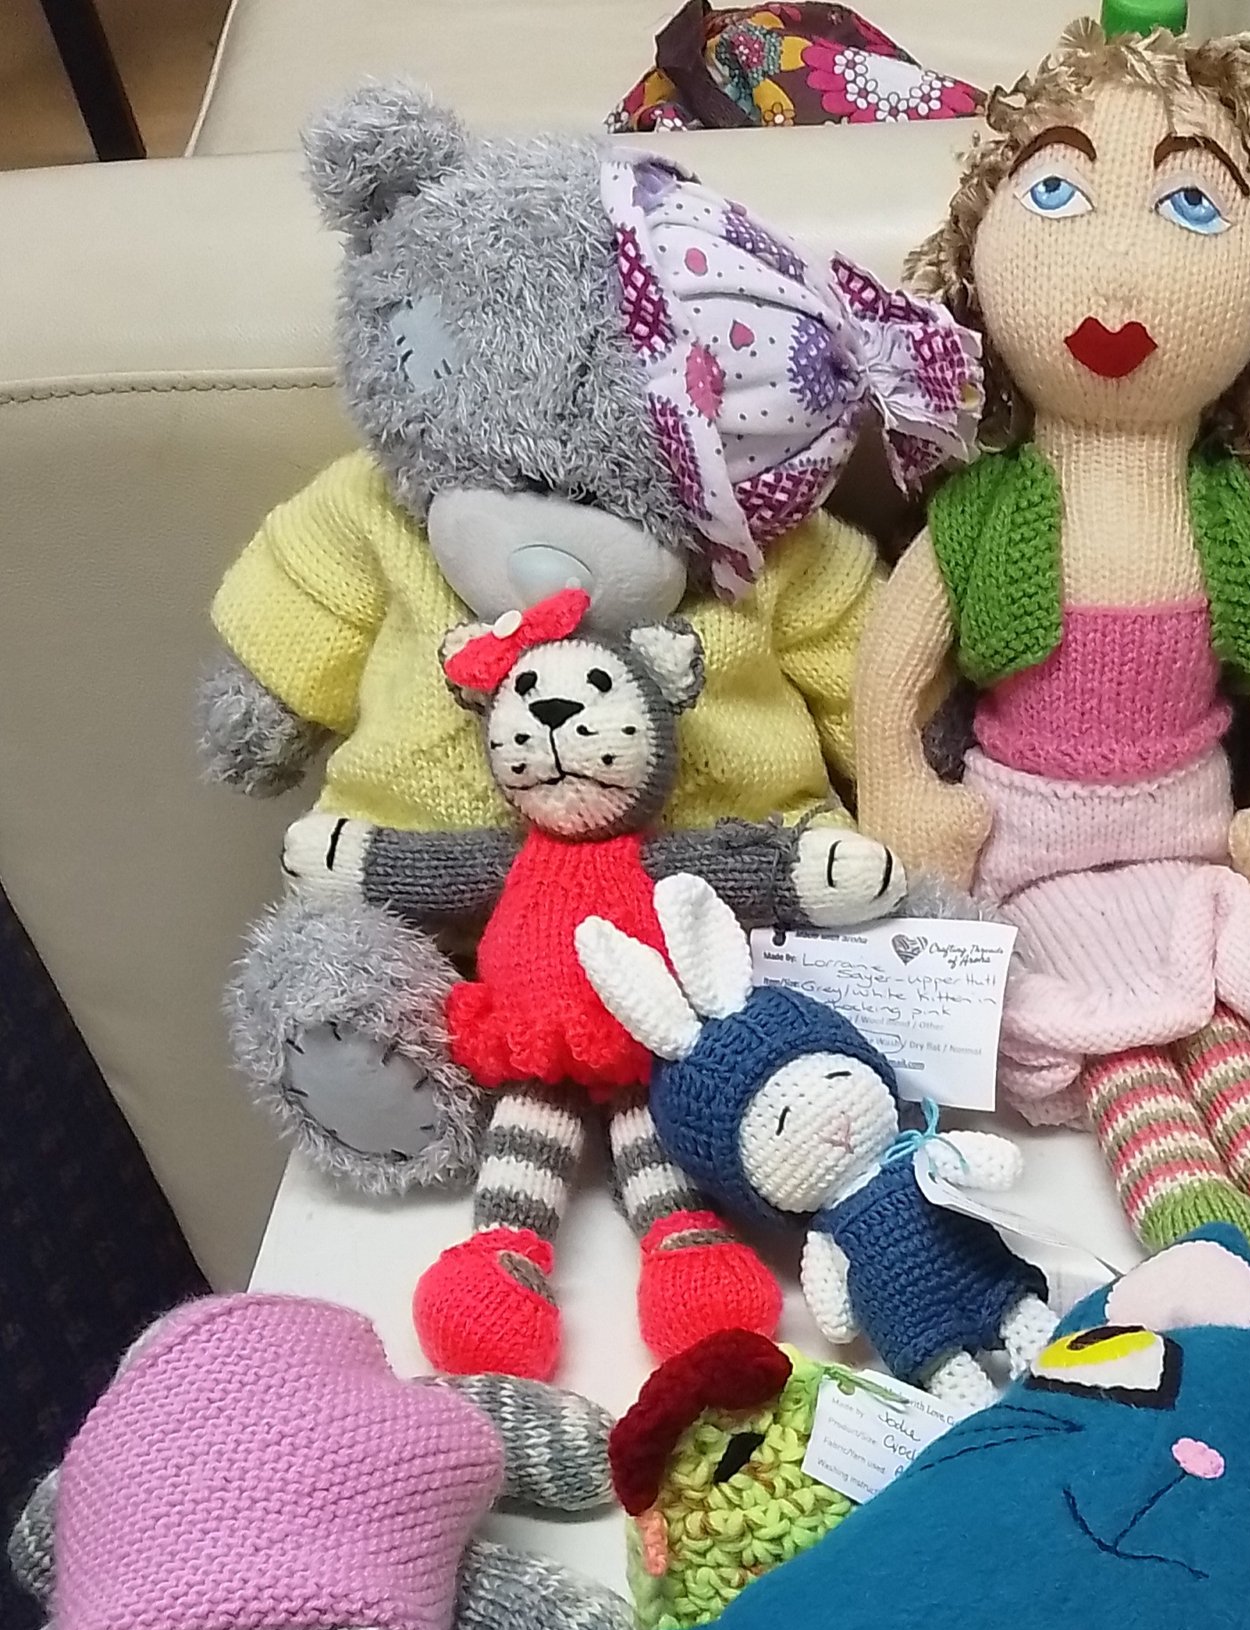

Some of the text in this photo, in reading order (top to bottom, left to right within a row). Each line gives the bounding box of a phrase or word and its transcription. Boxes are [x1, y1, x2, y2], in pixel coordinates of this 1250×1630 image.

[763, 952, 797, 963] Made By:
[911, 1005, 951, 1020] pink
[909, 1040, 924, 1051] Dry
[817, 1457, 849, 1482] Washing
